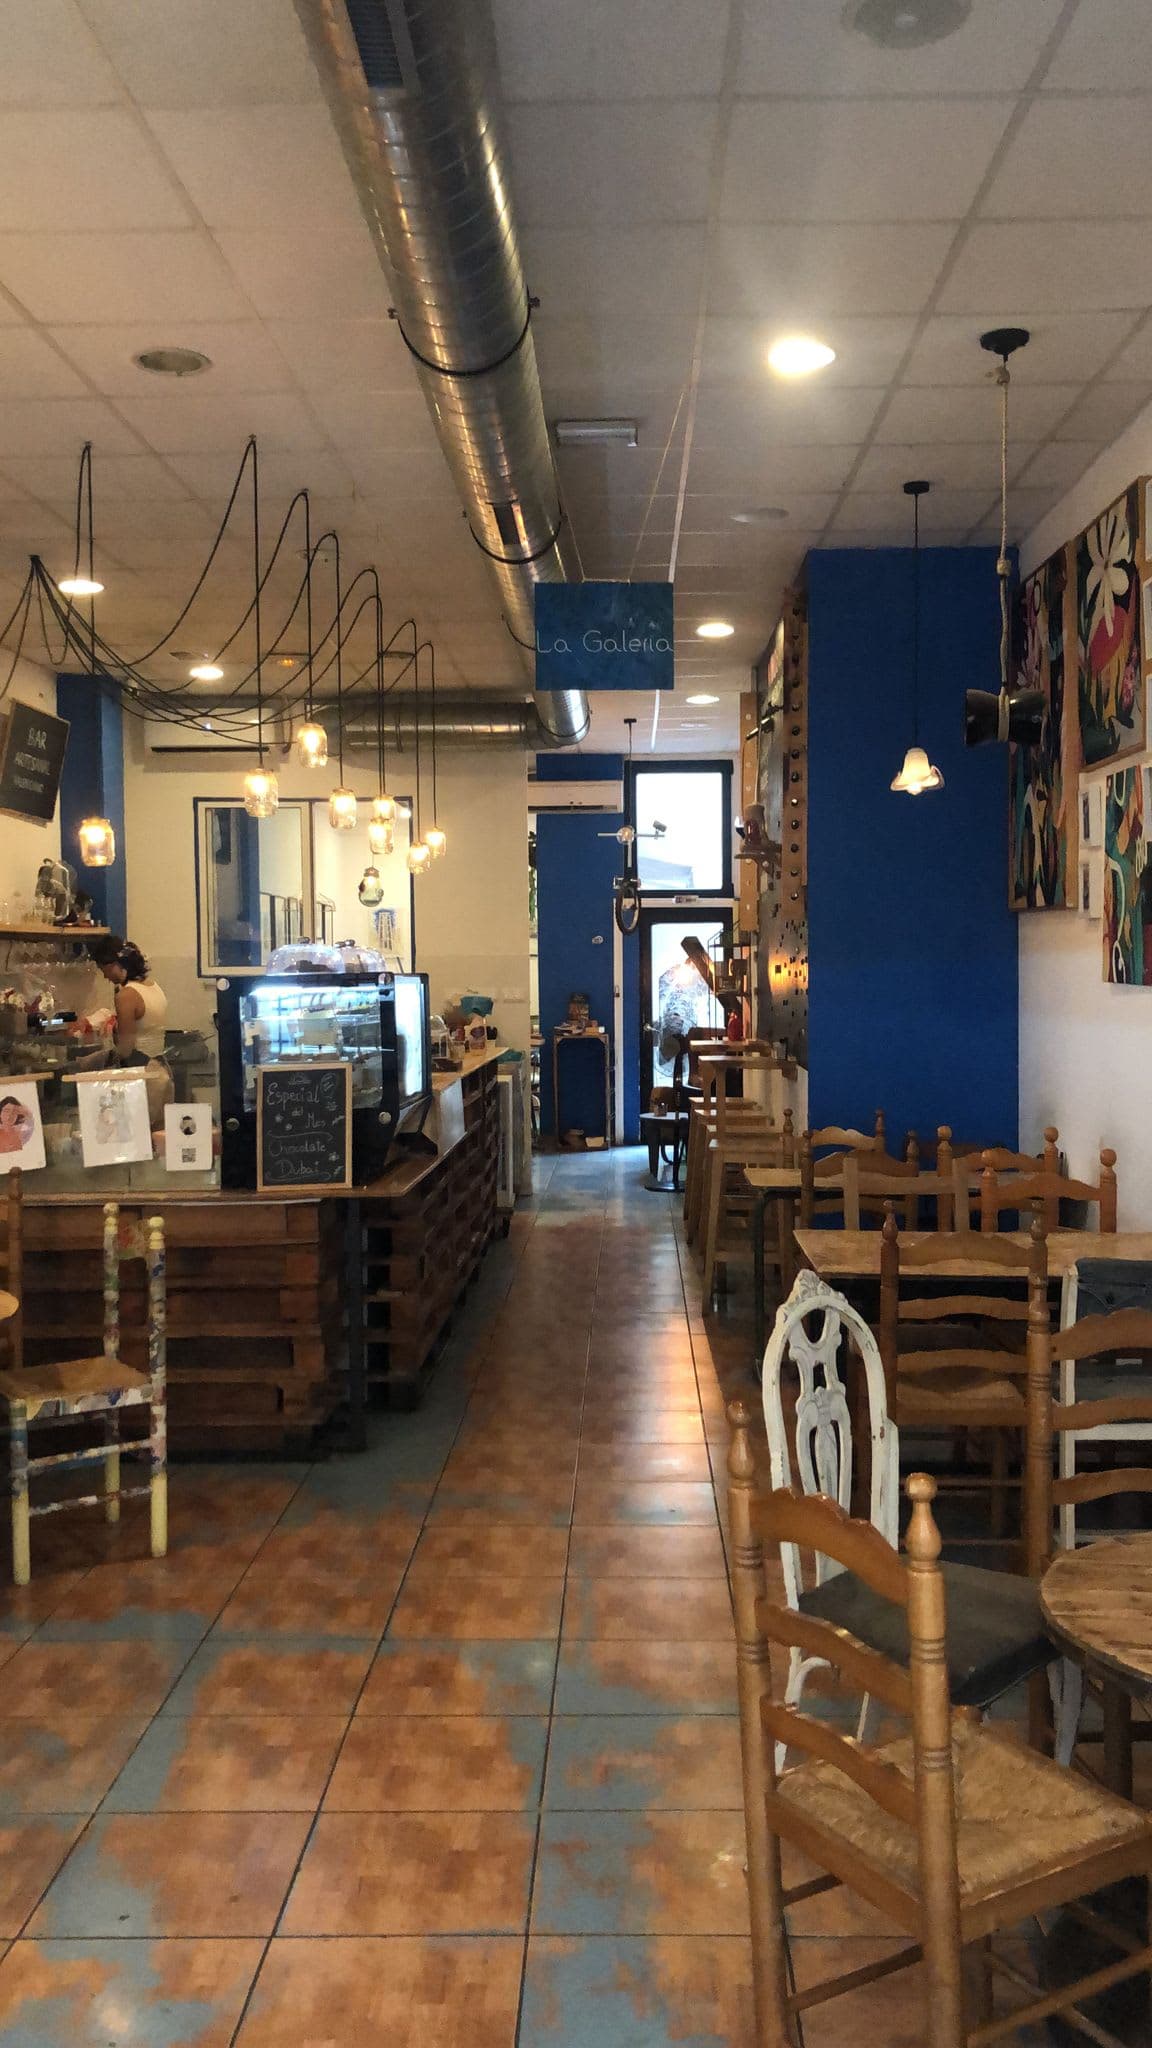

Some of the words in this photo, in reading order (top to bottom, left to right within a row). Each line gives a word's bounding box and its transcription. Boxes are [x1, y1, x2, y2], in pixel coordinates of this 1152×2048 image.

[536, 629, 572, 653] La
[27, 727, 47, 750] BAR
[266, 1082, 320, 1111] Especial
[292, 1106, 304, 1116] del
[275, 1159, 319, 1178] Dubai
